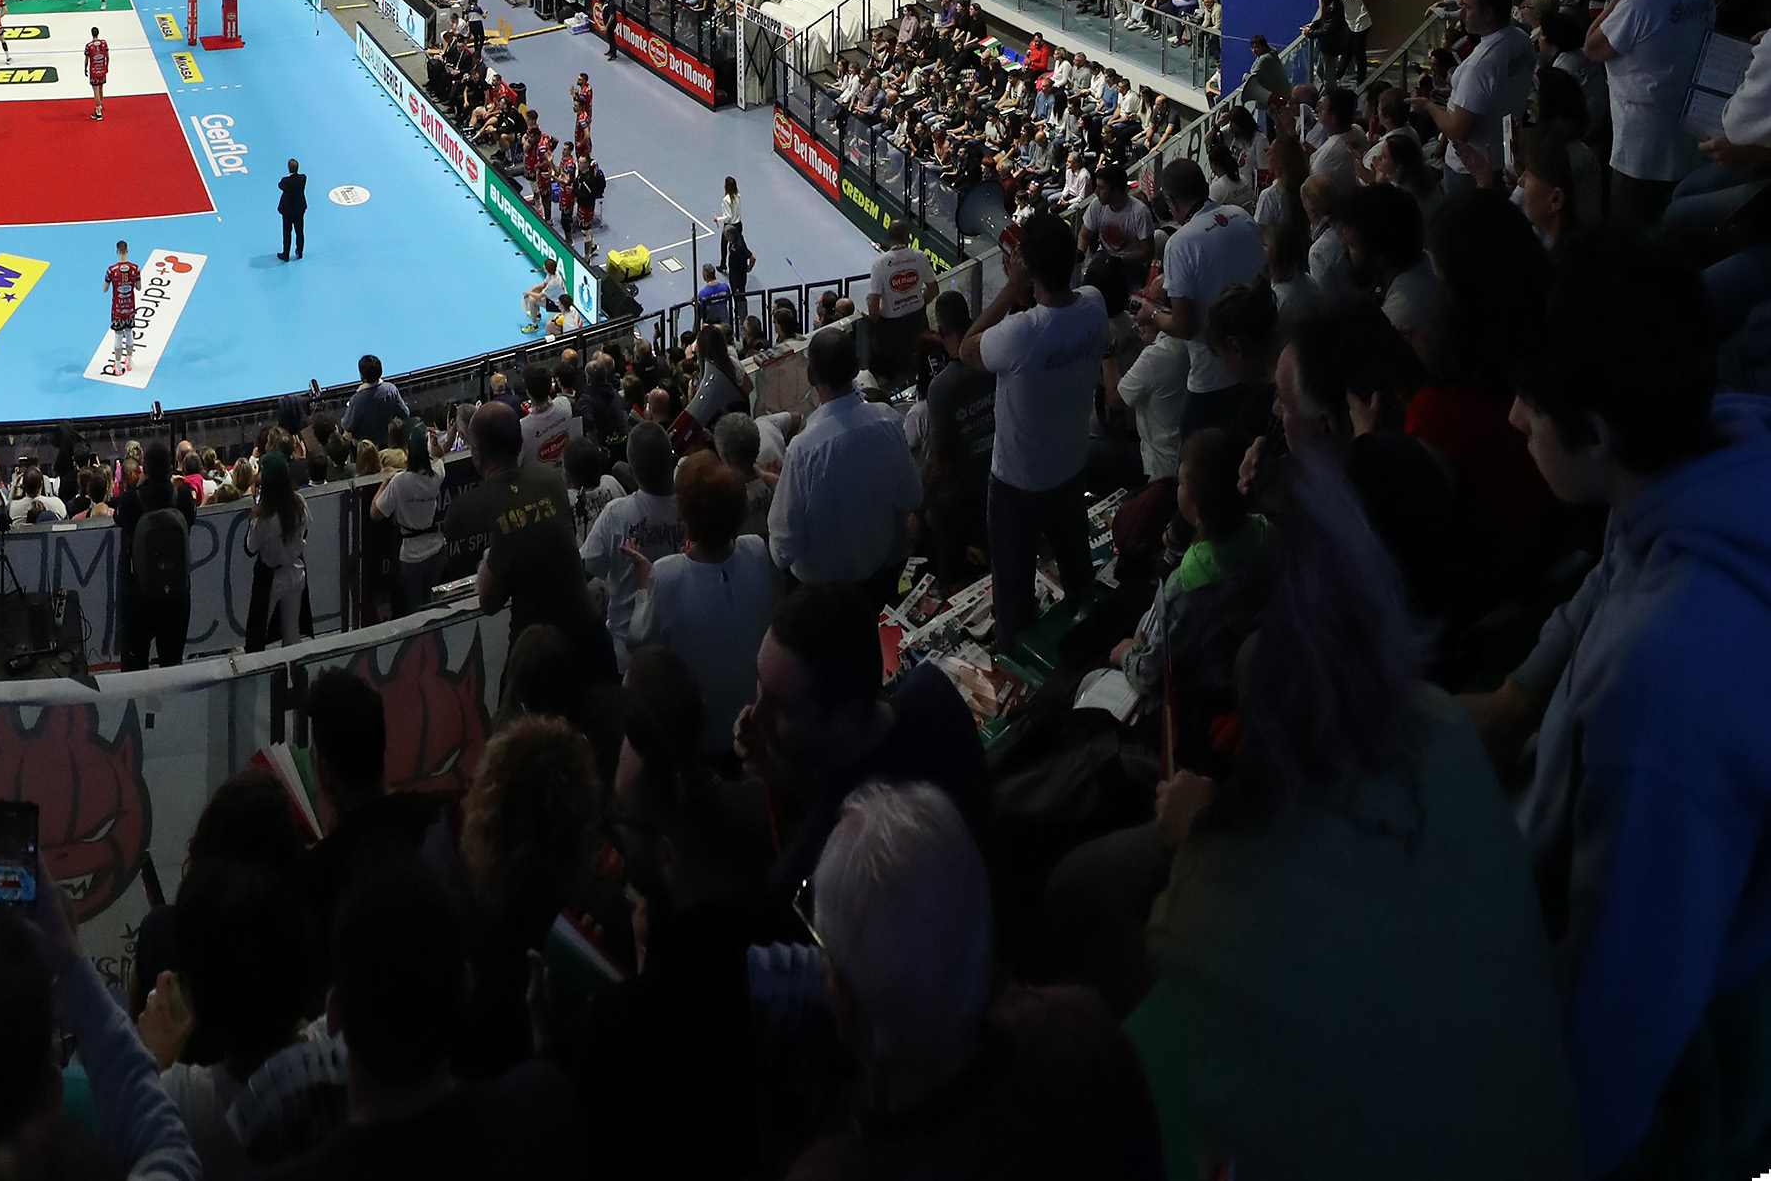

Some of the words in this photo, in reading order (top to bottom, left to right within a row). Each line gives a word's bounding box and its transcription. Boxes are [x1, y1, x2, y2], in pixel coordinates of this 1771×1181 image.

[623, 25, 648, 55] Monte
[745, 5, 782, 37] SUPERCOPPA
[174, 55, 194, 80] MIKASA
[669, 50, 683, 77] Del
[683, 63, 713, 95] Monte
[200, 113, 249, 175] Gerflor
[420, 102, 434, 139] Del
[434, 117, 464, 172] Monte
[793, 133, 808, 163] Del
[808, 145, 839, 189] Monte
[841, 178, 880, 220] CREDEM
[489, 182, 567, 282] SUPERCOPPA
